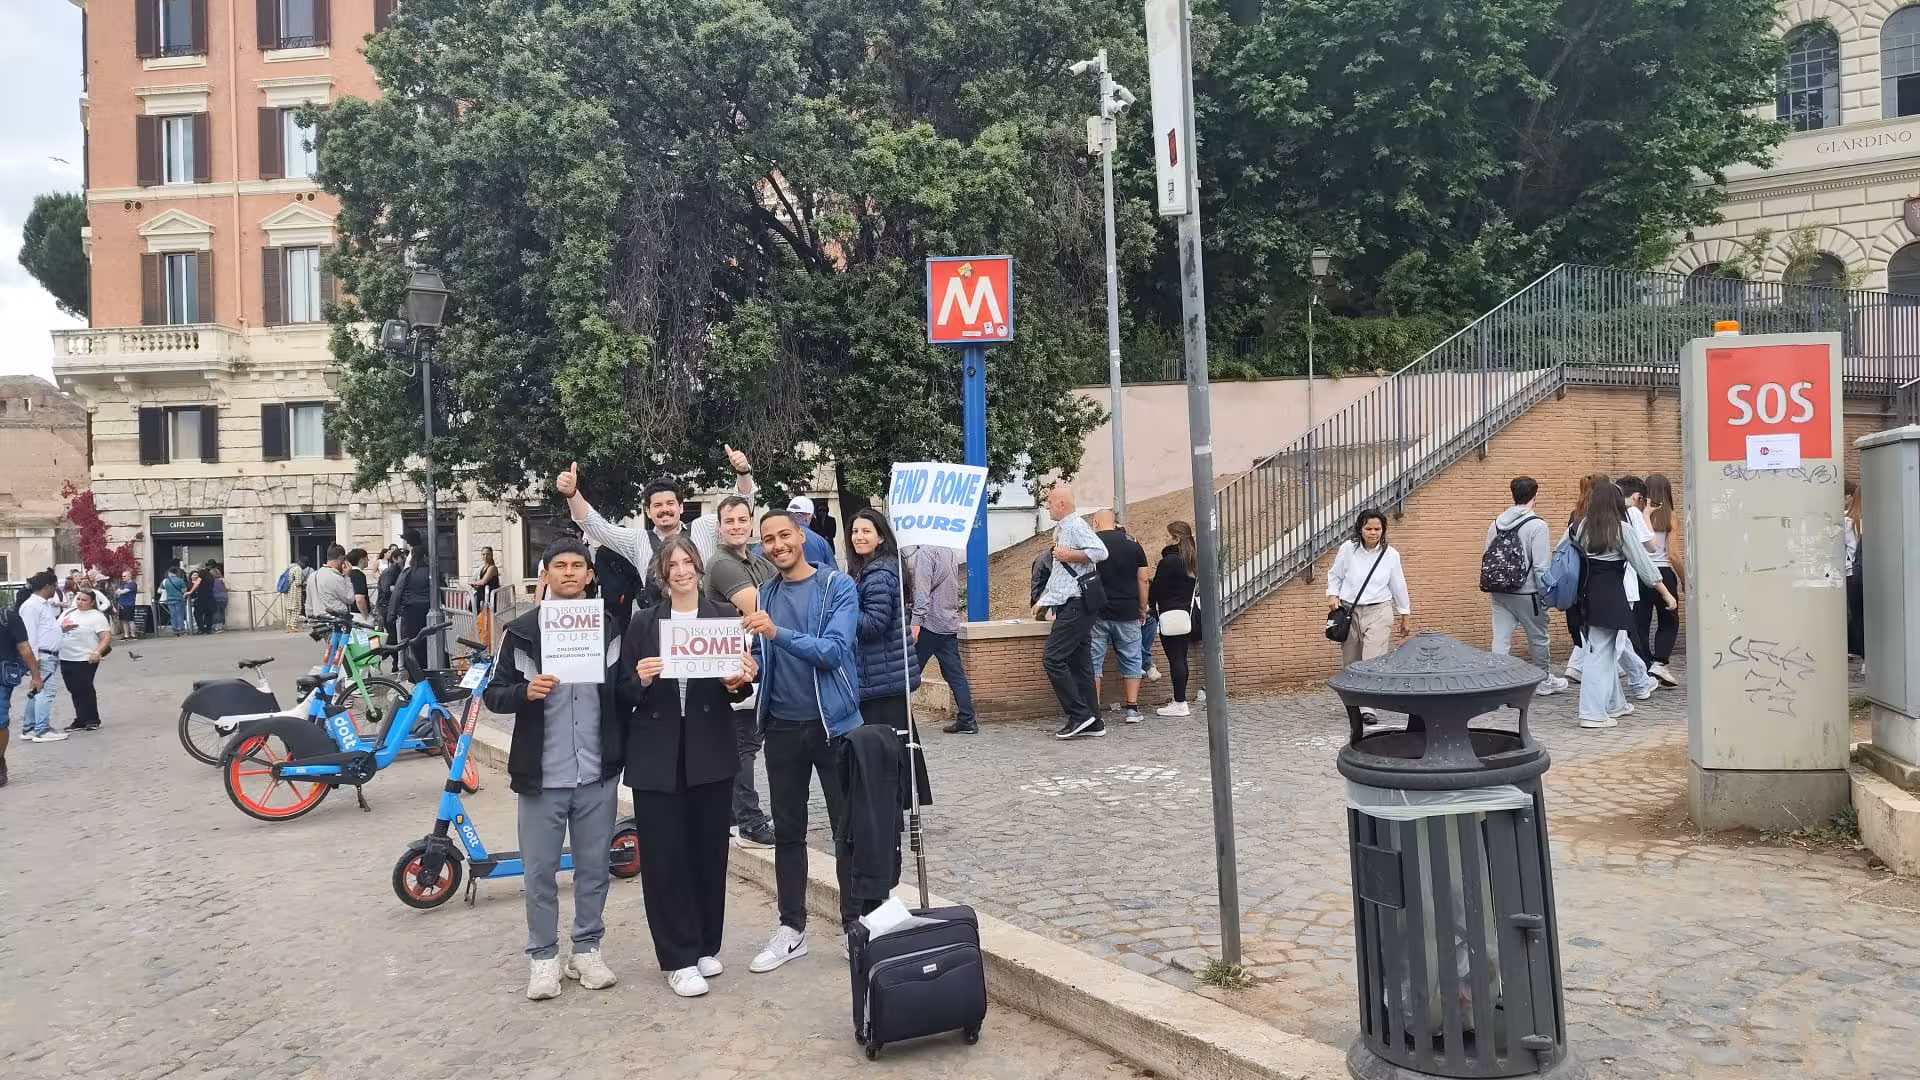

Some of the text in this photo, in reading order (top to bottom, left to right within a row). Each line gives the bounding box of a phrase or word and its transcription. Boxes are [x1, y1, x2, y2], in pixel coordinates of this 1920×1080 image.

[1816, 130, 1912, 154] GIARDINO
[936, 275, 1004, 326] M
[1727, 381, 1815, 426] SOS
[891, 469, 982, 507] FIND ROME
[894, 515, 967, 533] TOURS
[544, 614, 601, 630] ROME
[544, 632, 600, 643] TOURS
[671, 636, 742, 656] ROME
[671, 660, 740, 673] TOURS
[334, 717, 357, 750] dott
[462, 825, 479, 848] dott
